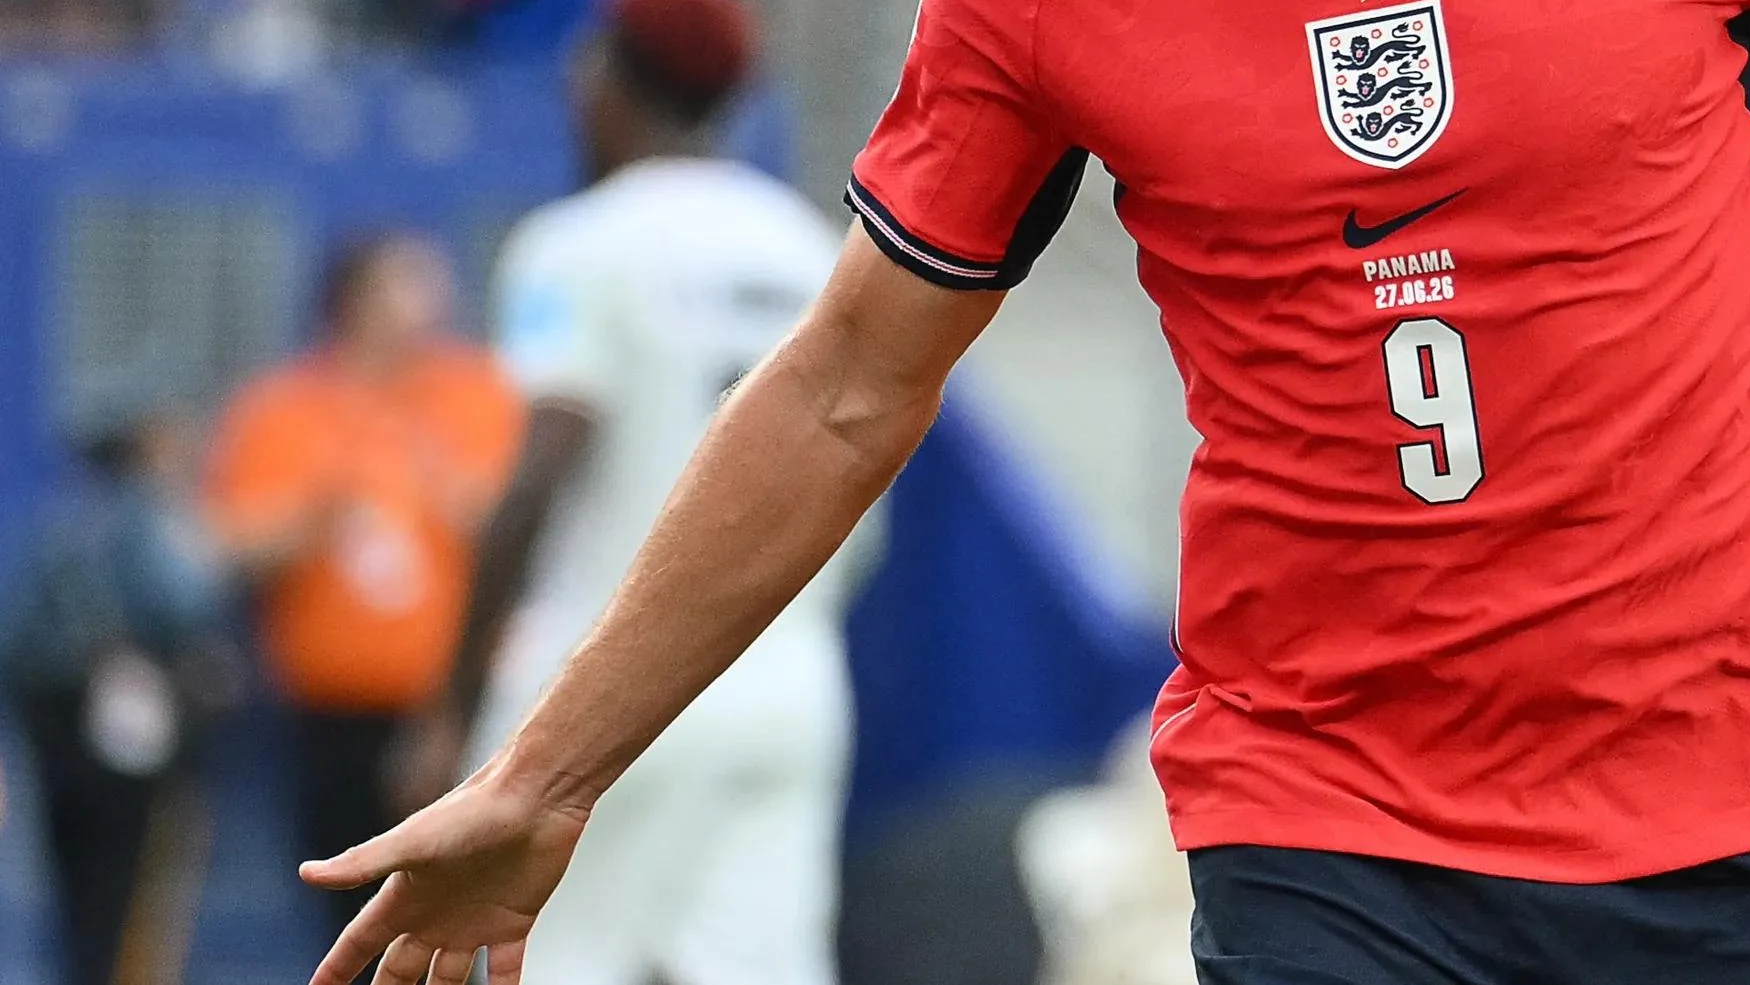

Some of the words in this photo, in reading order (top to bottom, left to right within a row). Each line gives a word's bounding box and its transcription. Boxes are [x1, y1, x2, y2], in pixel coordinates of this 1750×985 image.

[1362, 248, 1455, 282] PANAMA
[1374, 275, 1455, 310] 27.06.26
[1381, 317, 1485, 506] 9
